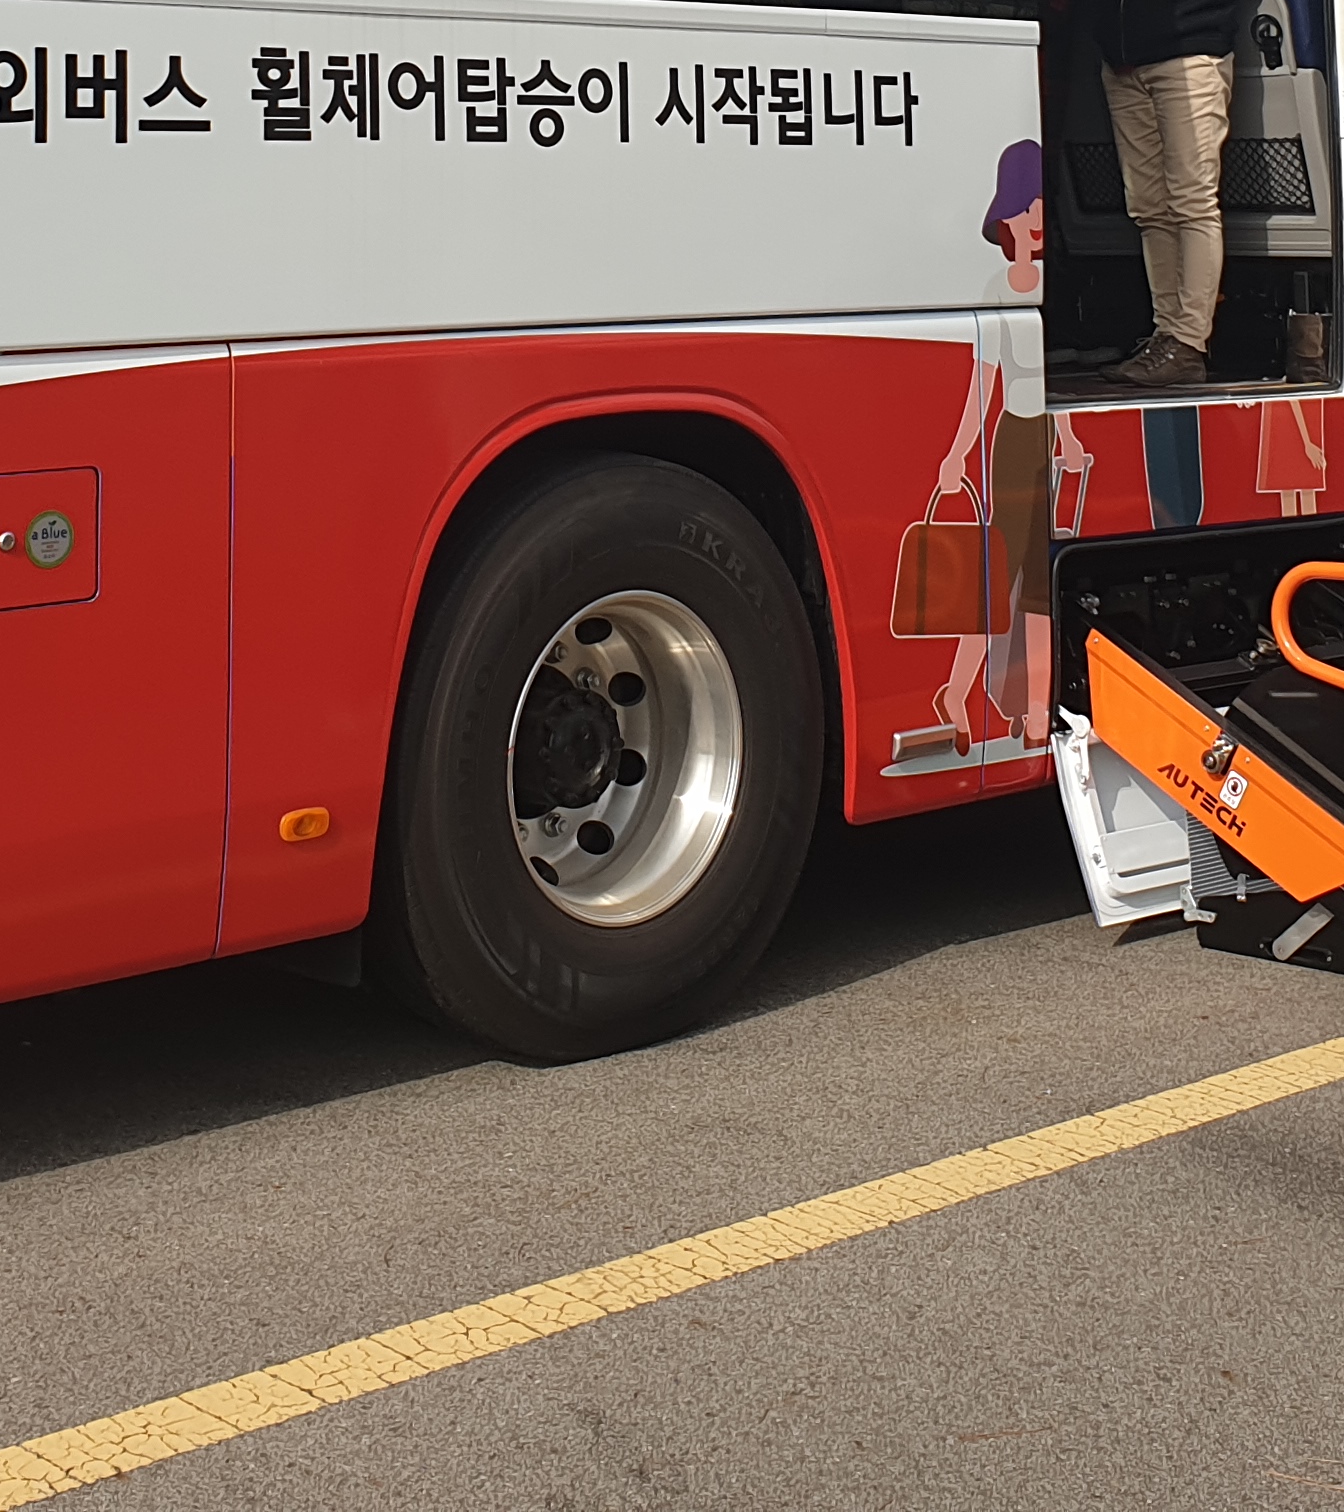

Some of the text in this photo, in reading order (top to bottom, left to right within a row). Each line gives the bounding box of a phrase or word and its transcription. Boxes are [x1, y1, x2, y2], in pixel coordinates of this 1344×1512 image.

[252, 47, 629, 147] 휠체어탑승이
[655, 64, 918, 146] 시작됩니다
[1157, 763, 1247, 837] AUTECH
